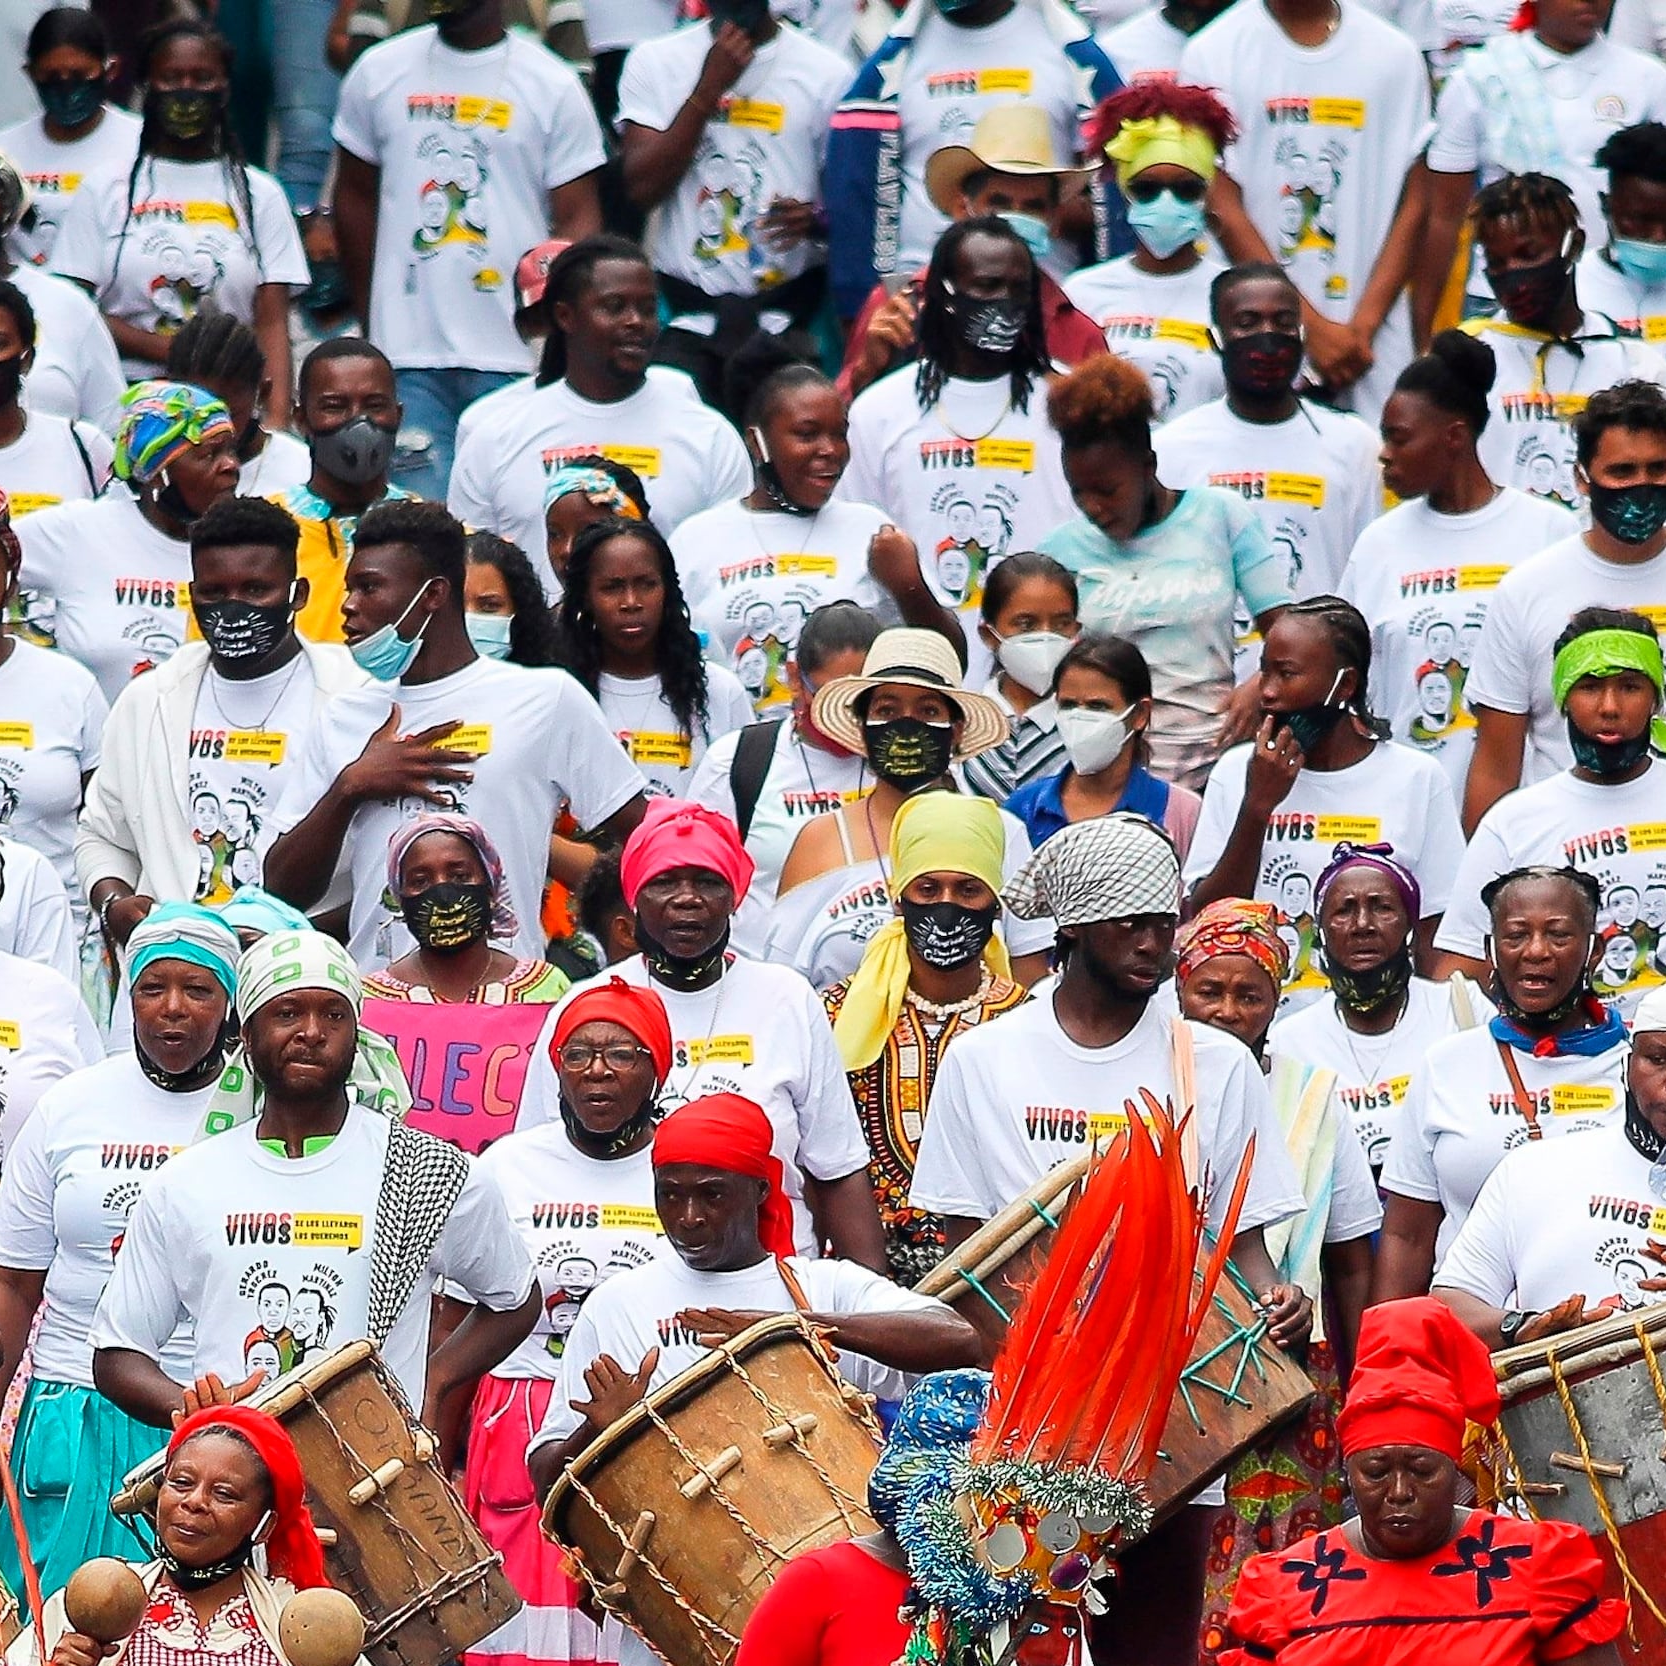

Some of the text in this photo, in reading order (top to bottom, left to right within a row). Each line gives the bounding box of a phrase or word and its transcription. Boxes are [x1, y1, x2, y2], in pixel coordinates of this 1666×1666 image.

[116, 578, 176, 609] VIVOS
[1267, 814, 1315, 841] IVOS
[1564, 828, 1628, 866] VIVOS
[827, 880, 889, 920] VIVOS
[1025, 1107, 1086, 1143] VIVOS
[321, 1220, 358, 1228] LLEVARON
[533, 1203, 598, 1229] VIVOS
[1588, 1195, 1654, 1230] VIVOS
[226, 1212, 292, 1246] VIVOS
[309, 1232, 348, 1240] QUEREMOS
[623, 1239, 654, 1261] MILTON
[247, 1270, 277, 1298] TROCHEZ
[302, 1275, 337, 1298] MARTINEZ
[313, 1262, 344, 1287] MILTON
